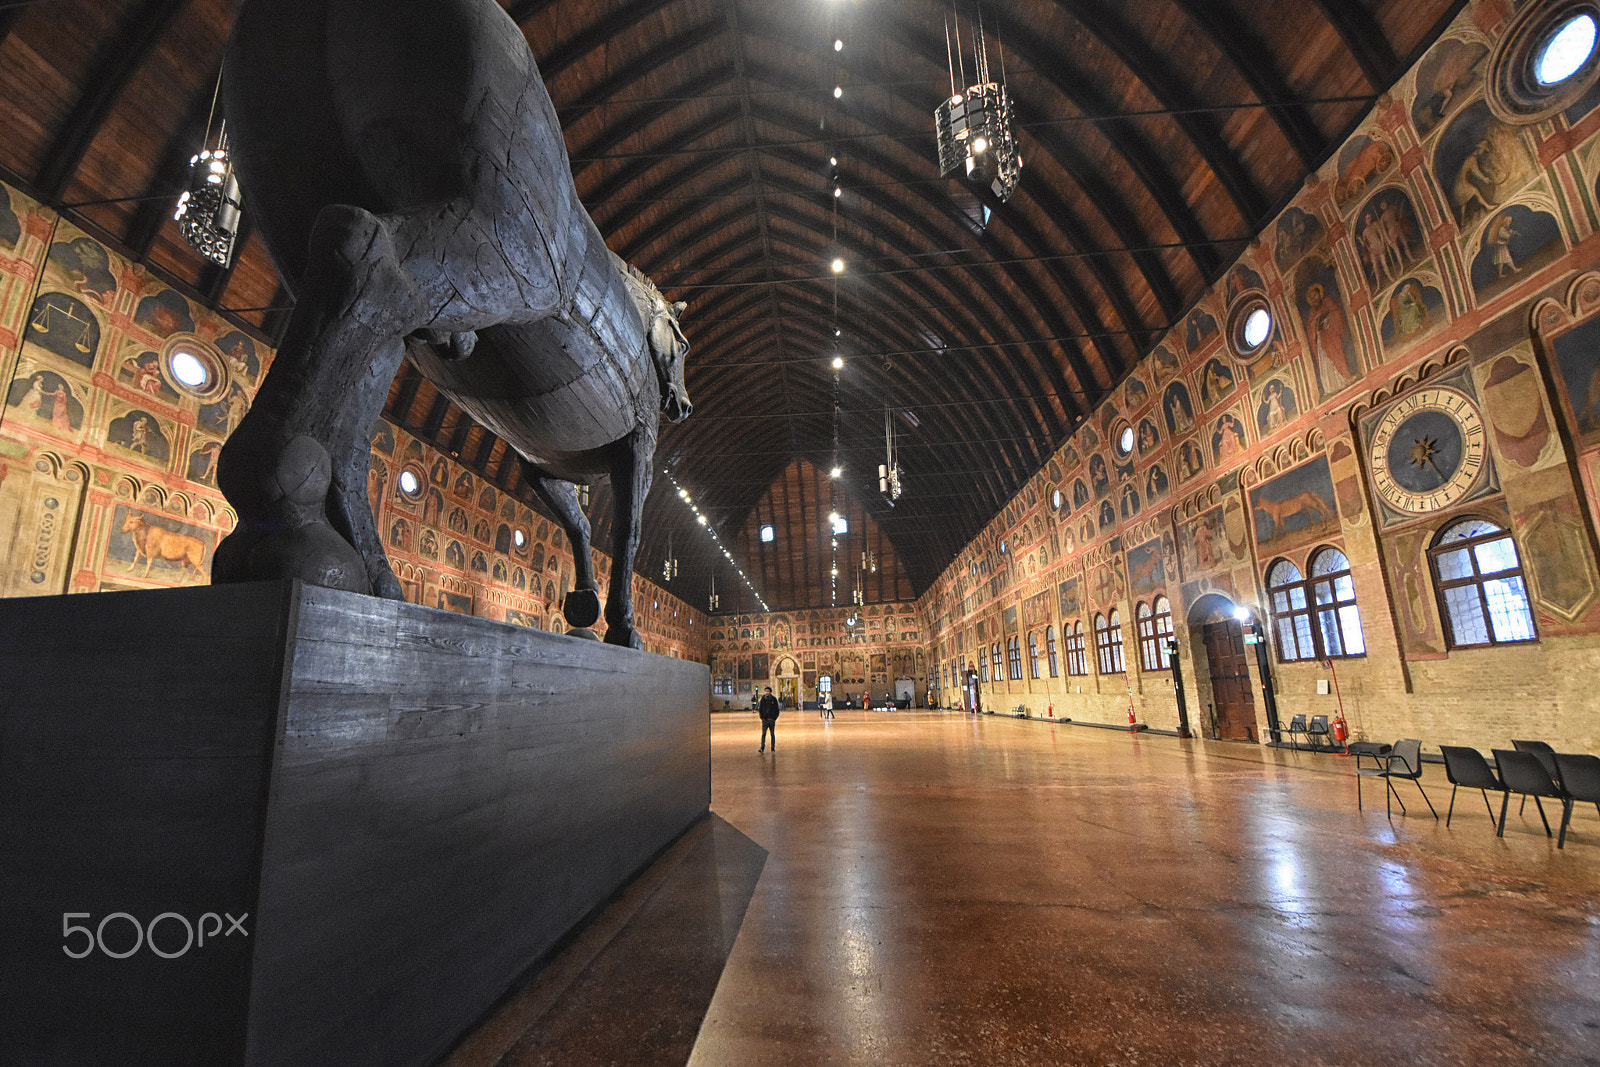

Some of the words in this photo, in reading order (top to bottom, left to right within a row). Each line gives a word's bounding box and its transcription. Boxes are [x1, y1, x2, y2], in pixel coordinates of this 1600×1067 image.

[1405, 395, 1418, 409] XII
[1454, 400, 1467, 412] II
[1467, 424, 1482, 436] III
[1467, 454, 1482, 467] IIII
[1381, 484, 1396, 501] VIII
[1455, 483, 1466, 494] V
[1402, 497, 1415, 511] VII
[1429, 497, 1441, 511] VI
